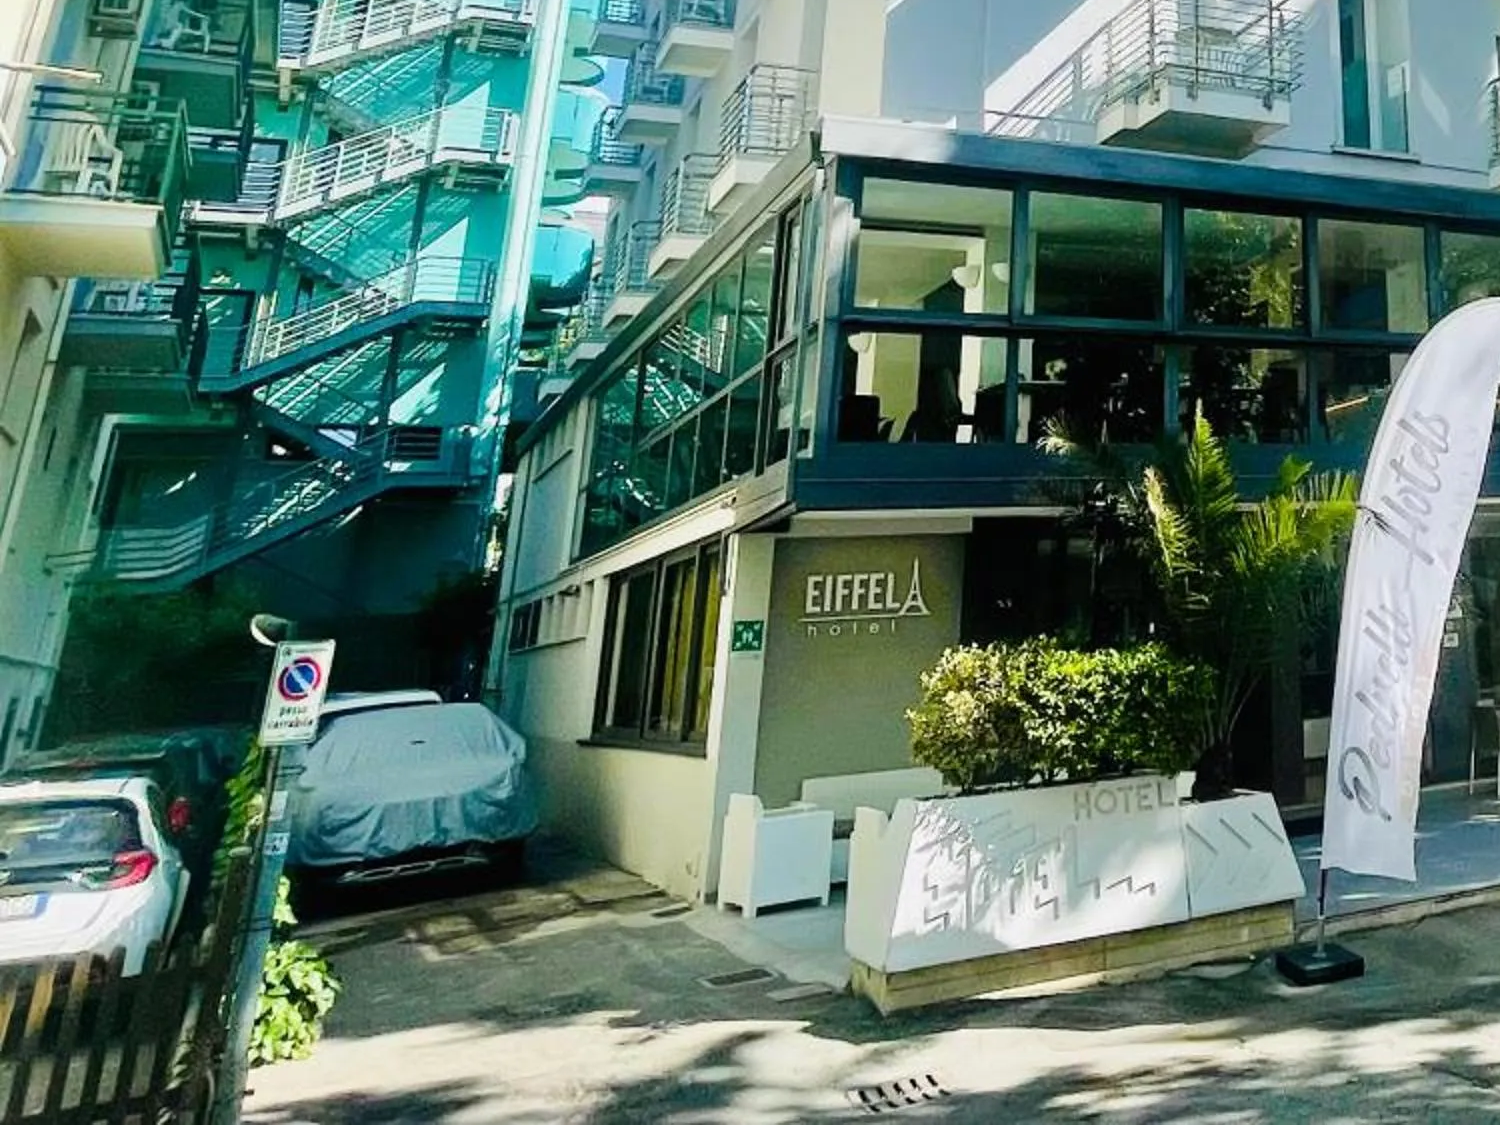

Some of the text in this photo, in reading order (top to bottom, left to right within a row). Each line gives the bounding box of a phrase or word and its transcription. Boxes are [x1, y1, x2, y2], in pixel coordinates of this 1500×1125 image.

[1375, 410, 1450, 590] Hotels
[805, 571, 901, 614] EIFFEL
[807, 618, 895, 638] hotel
[1073, 781, 1177, 821] HOTEL
